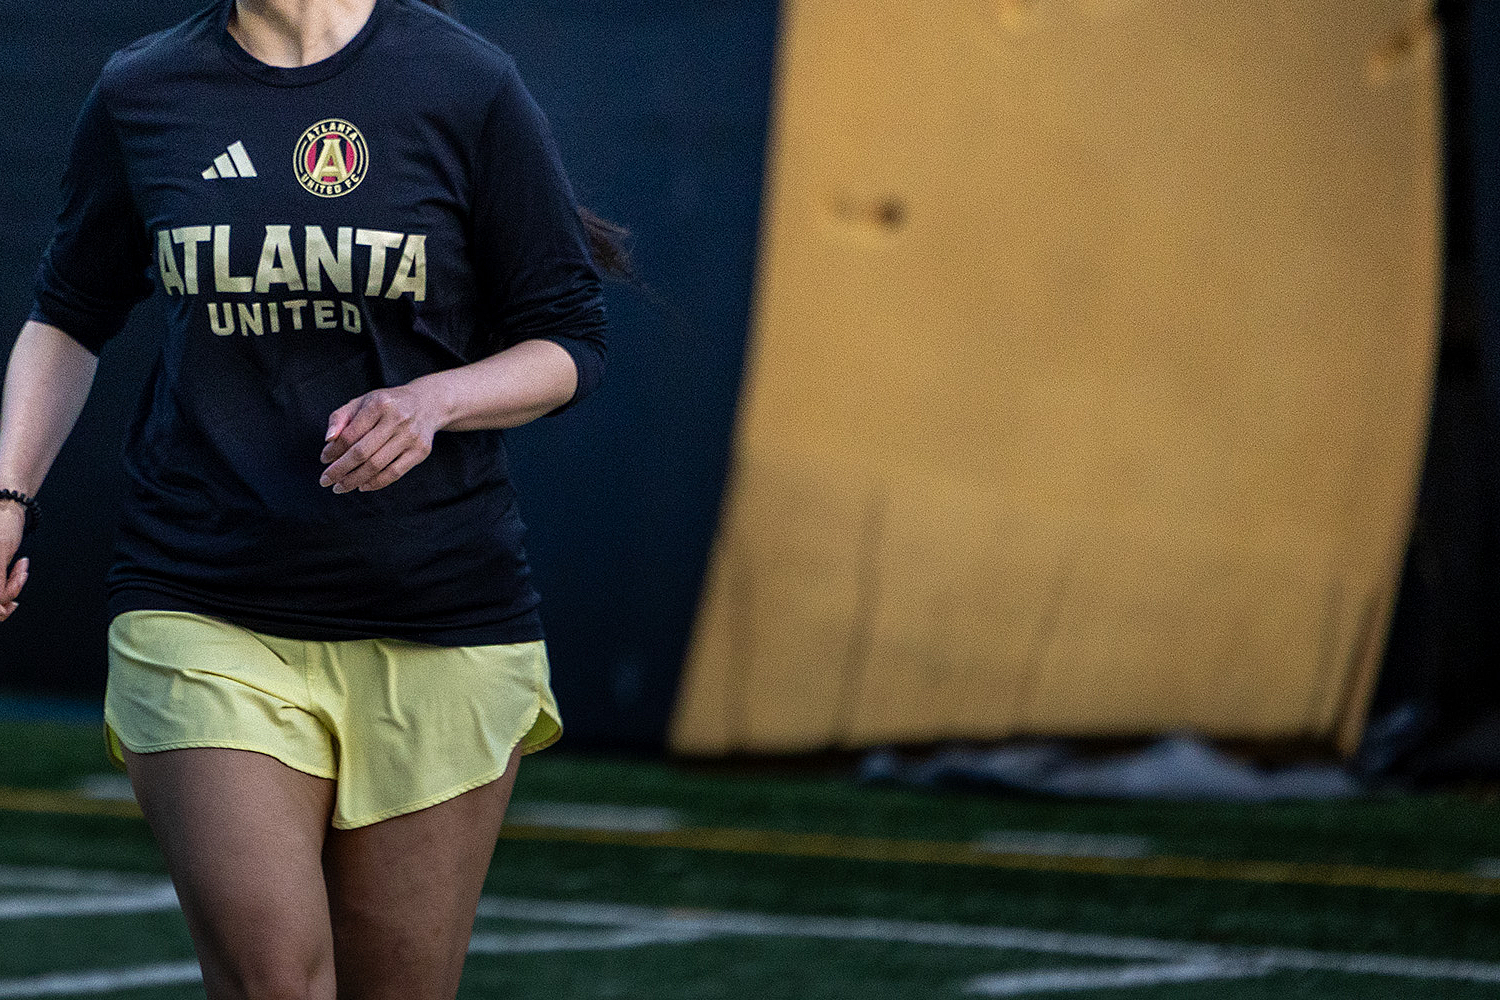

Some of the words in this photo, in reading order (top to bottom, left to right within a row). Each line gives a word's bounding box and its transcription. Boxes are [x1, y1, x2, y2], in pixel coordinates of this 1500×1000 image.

[306, 122, 358, 142] ATLANTA
[311, 139, 348, 181] A
[300, 173, 342, 194] UNITED
[344, 173, 360, 189] FC
[157, 224, 427, 302] ATLANTA
[207, 300, 362, 337] UNITED
